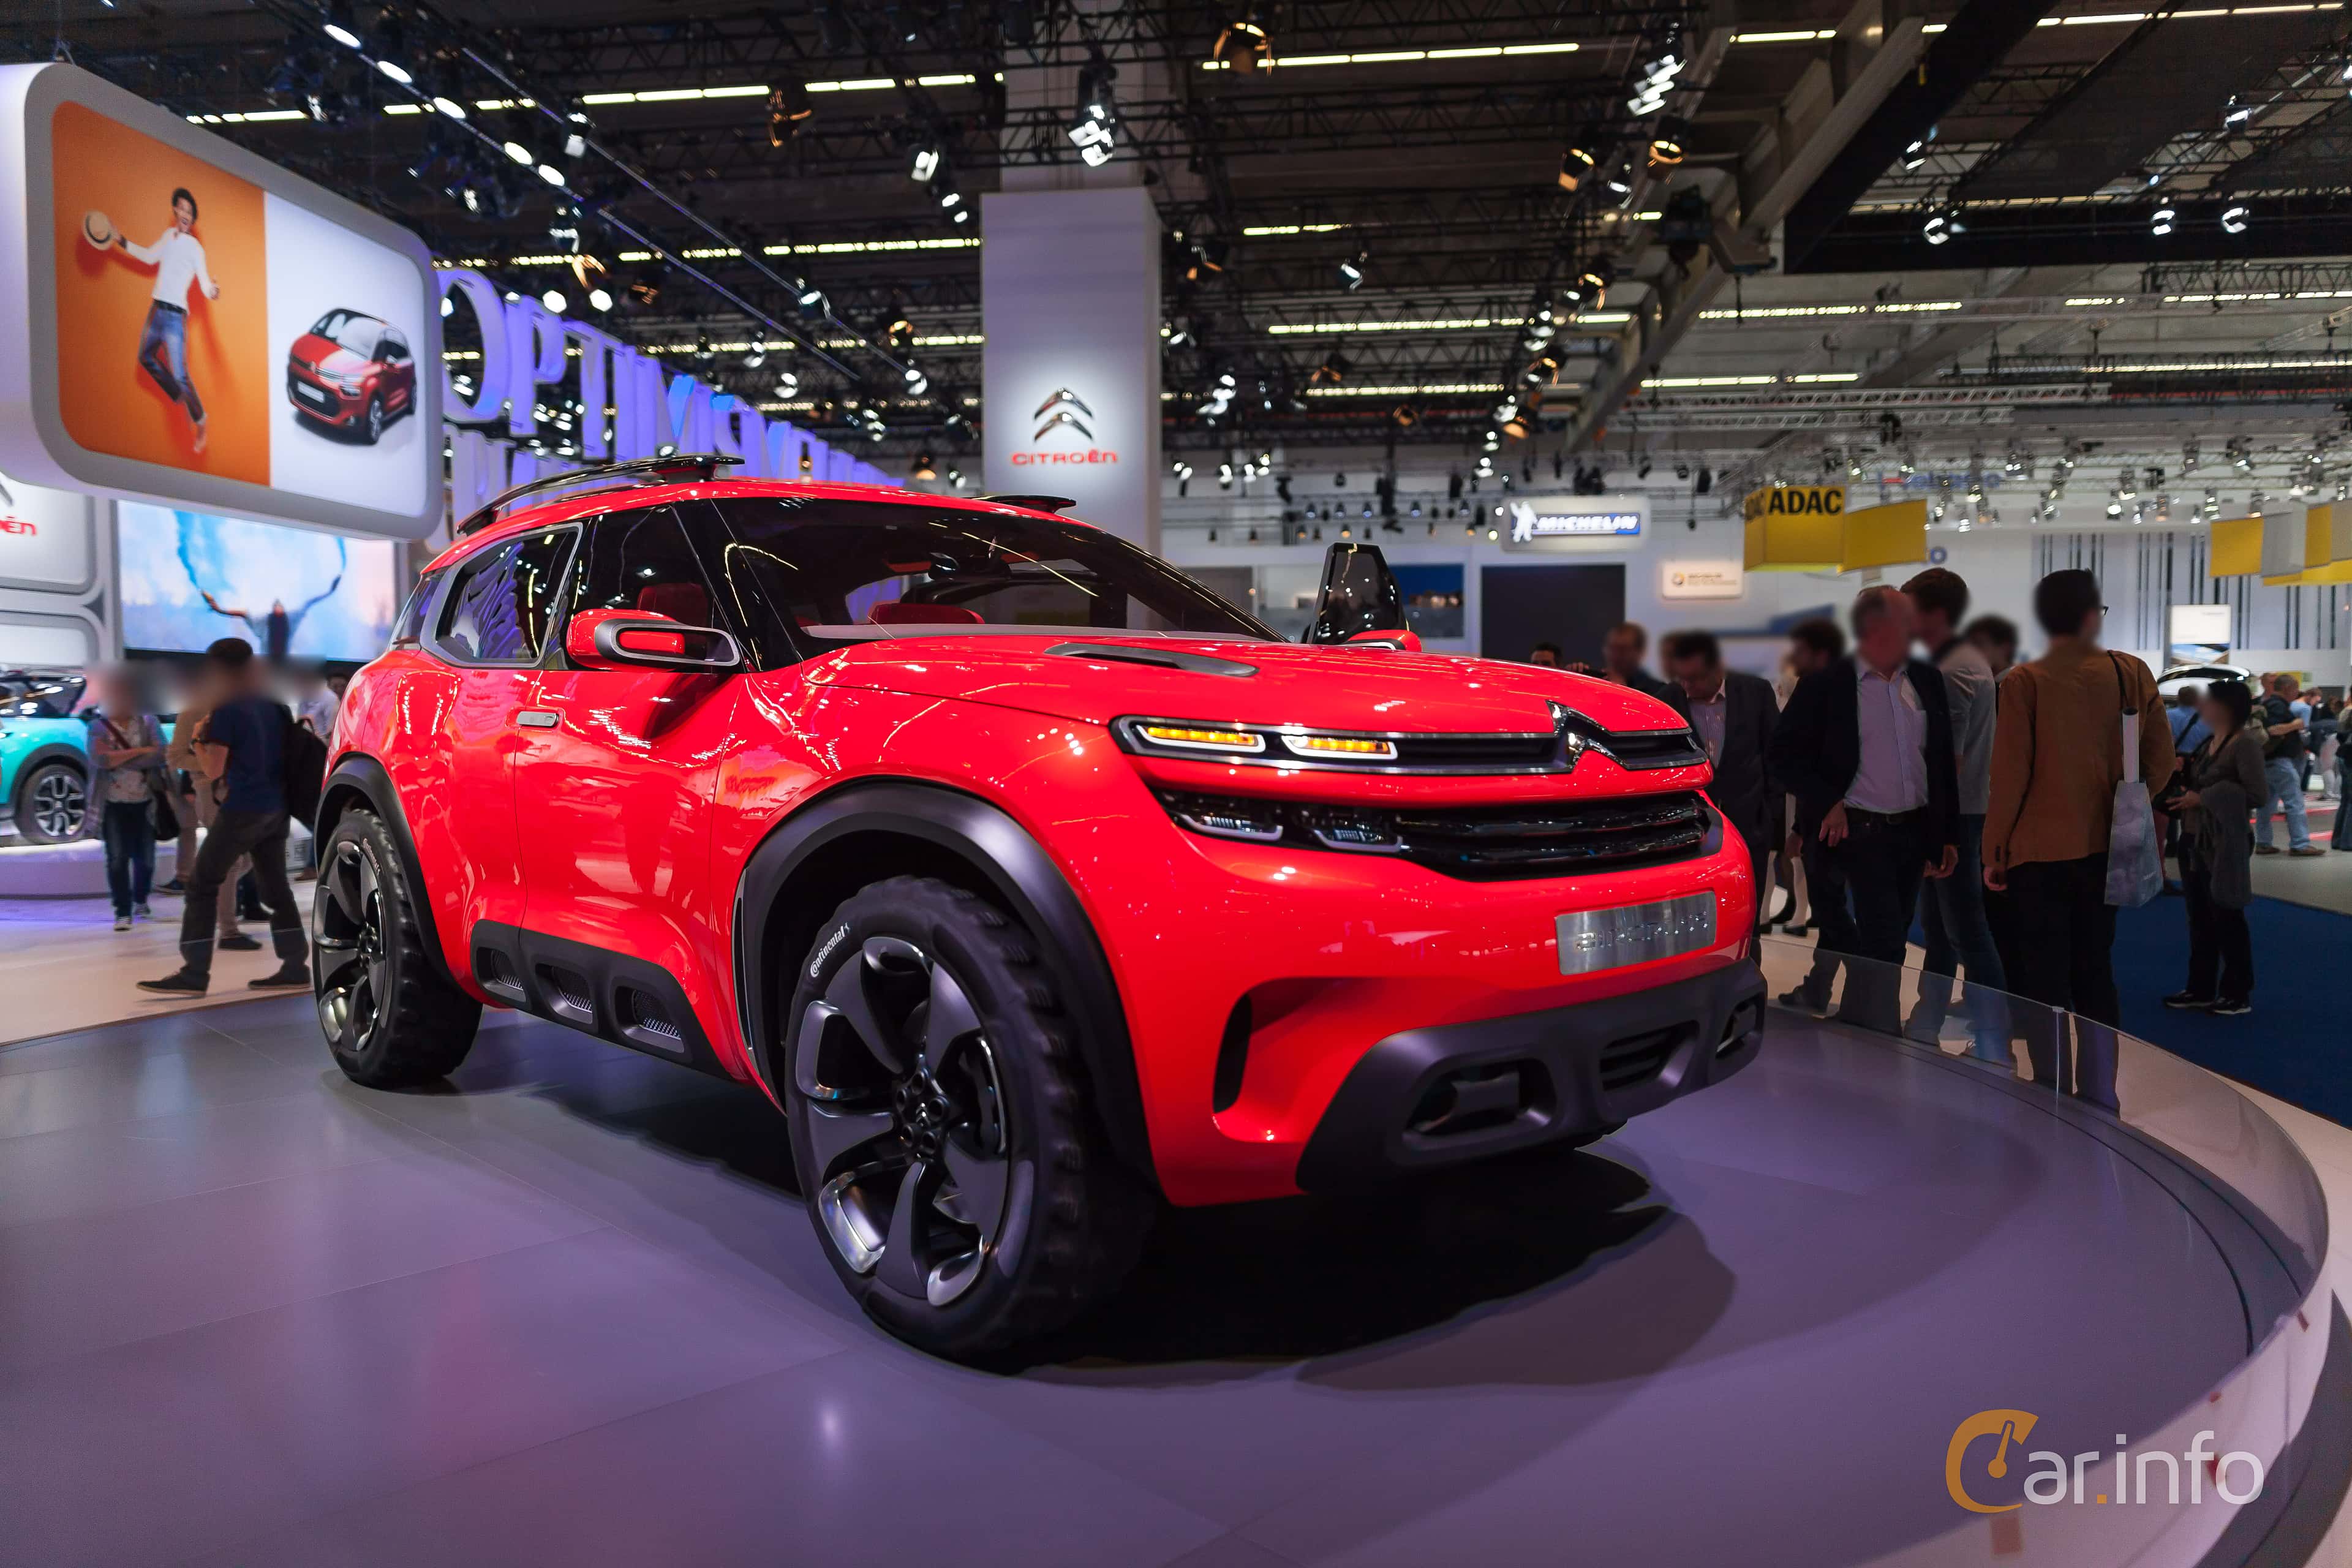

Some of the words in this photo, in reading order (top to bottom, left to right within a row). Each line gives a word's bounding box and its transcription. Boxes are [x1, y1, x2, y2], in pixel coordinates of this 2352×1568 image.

[1011, 448, 1117, 465] CITROËN
[1768, 490, 1842, 515] ADAC
[810, 925, 845, 978] Continental
